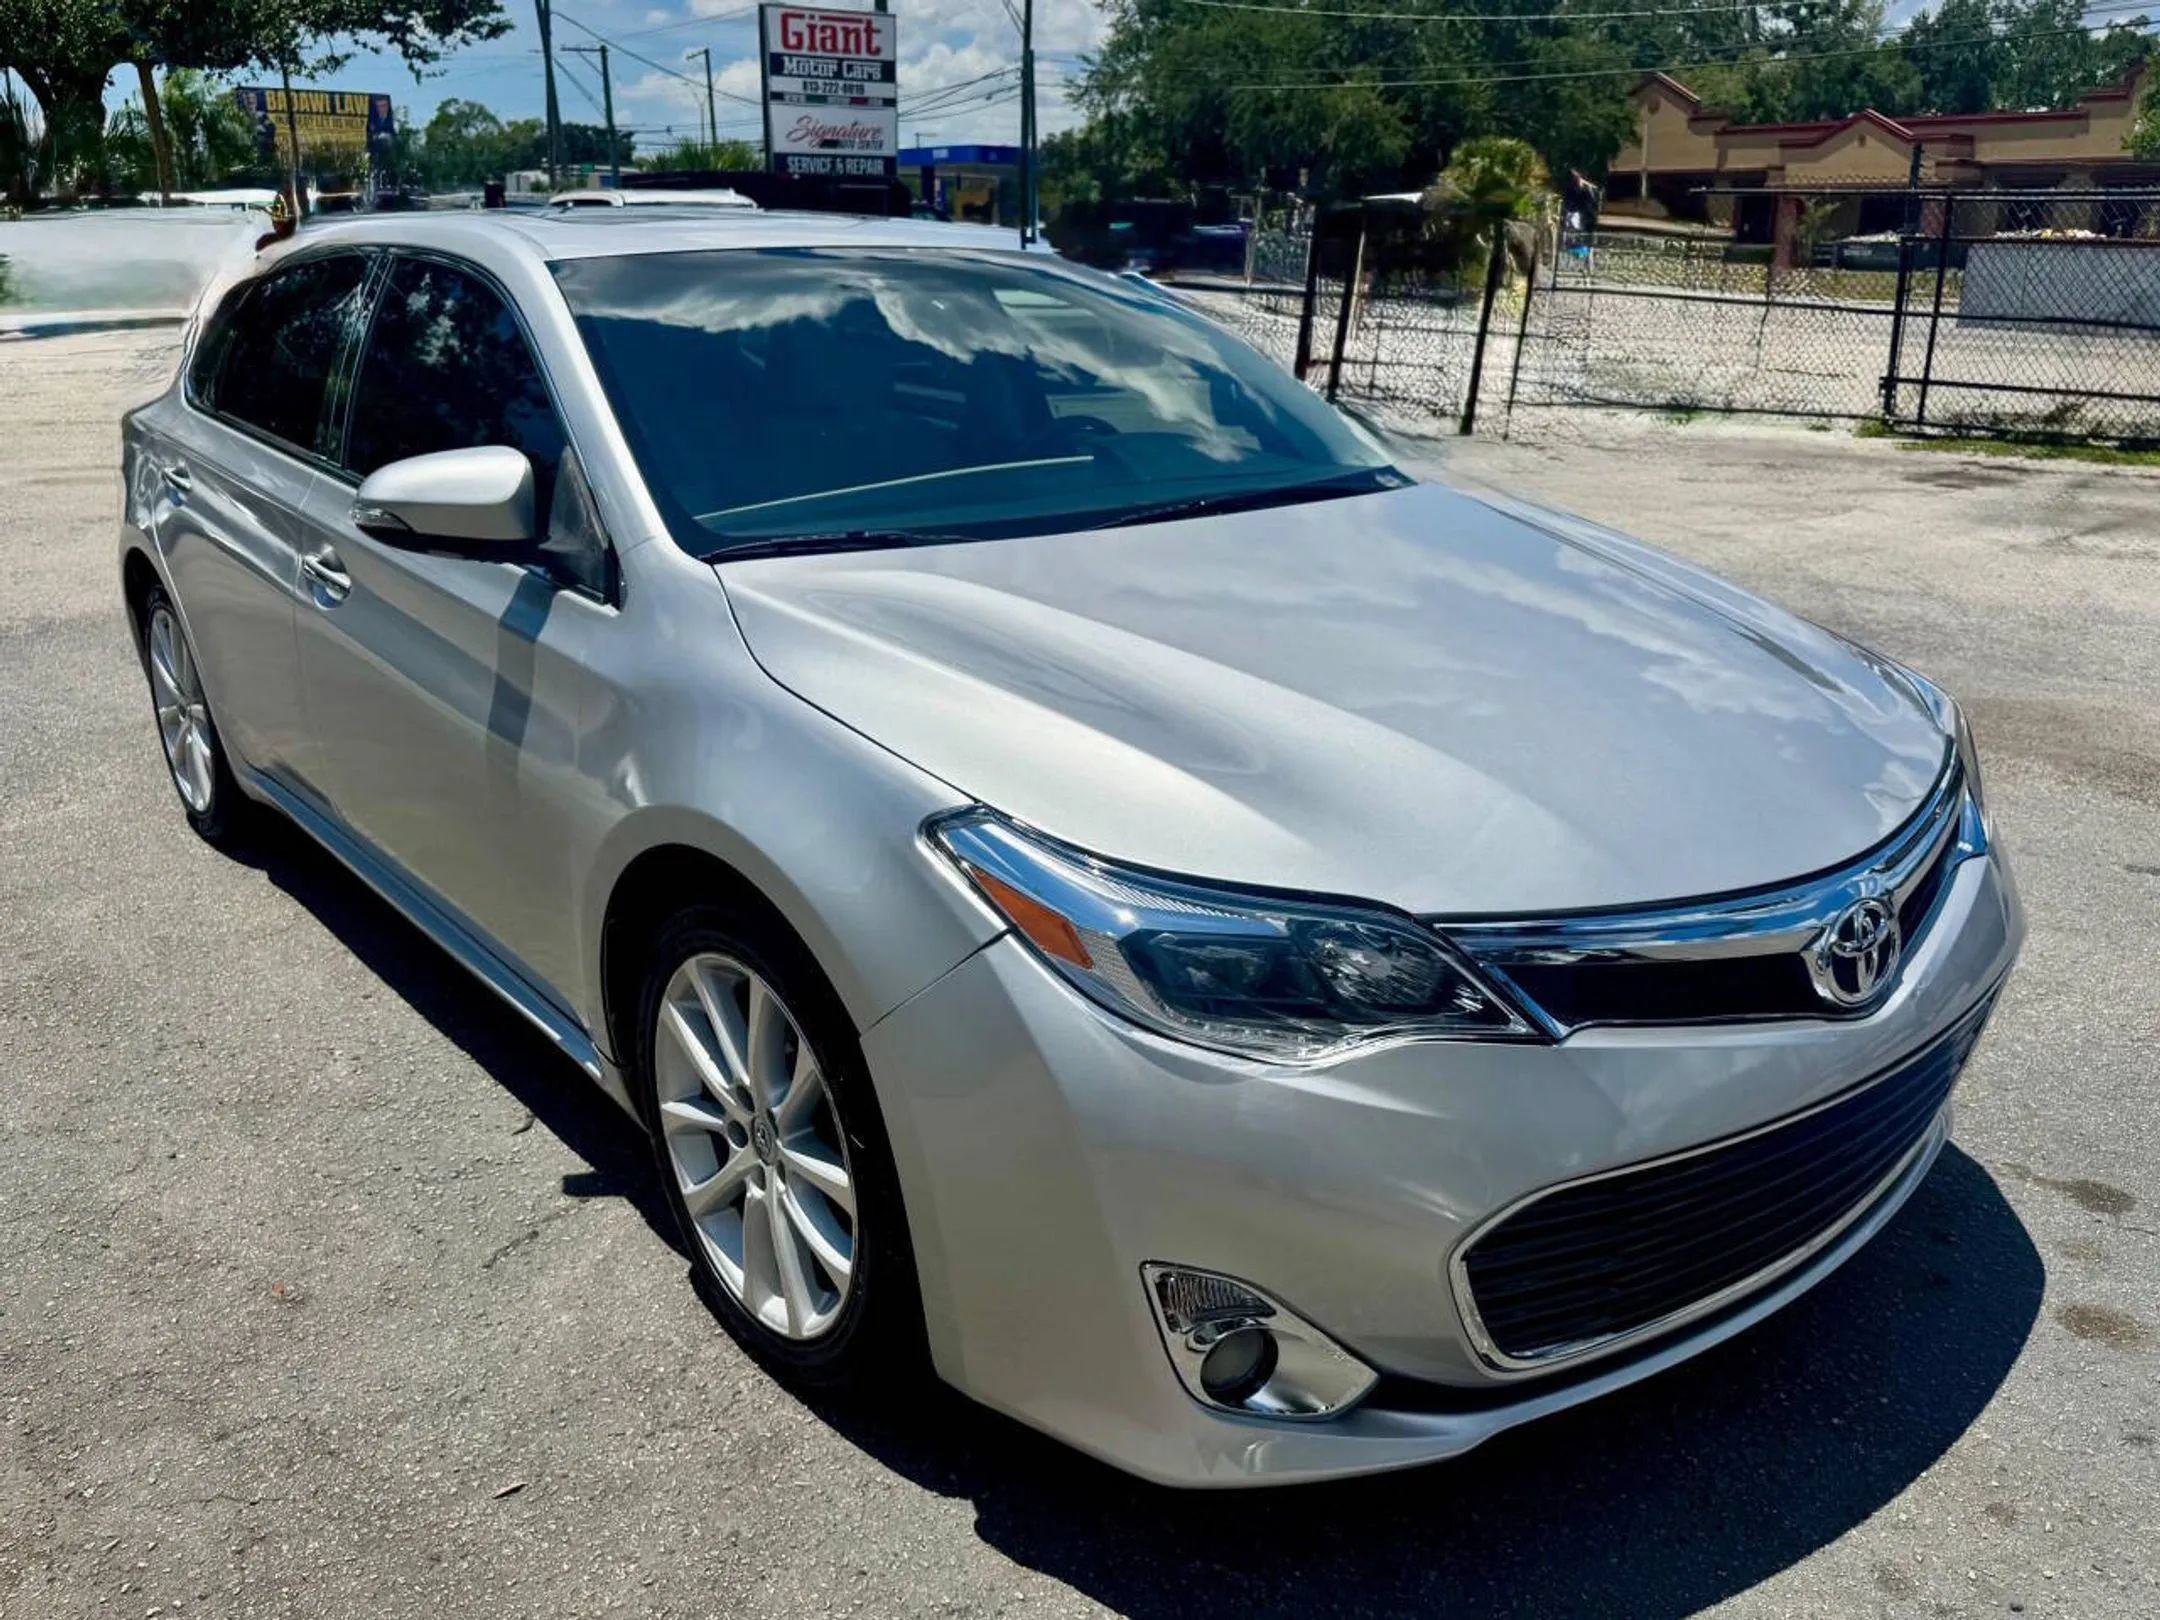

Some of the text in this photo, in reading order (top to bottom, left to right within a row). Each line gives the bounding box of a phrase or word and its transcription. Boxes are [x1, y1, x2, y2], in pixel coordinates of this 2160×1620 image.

[781, 12, 882, 57] Giant
[783, 55, 882, 80] Motor Cars
[335, 94, 369, 115] LAW
[786, 115, 883, 149] Signature
[787, 156, 832, 175] SERVICE
[846, 158, 884, 176] REPAIR
